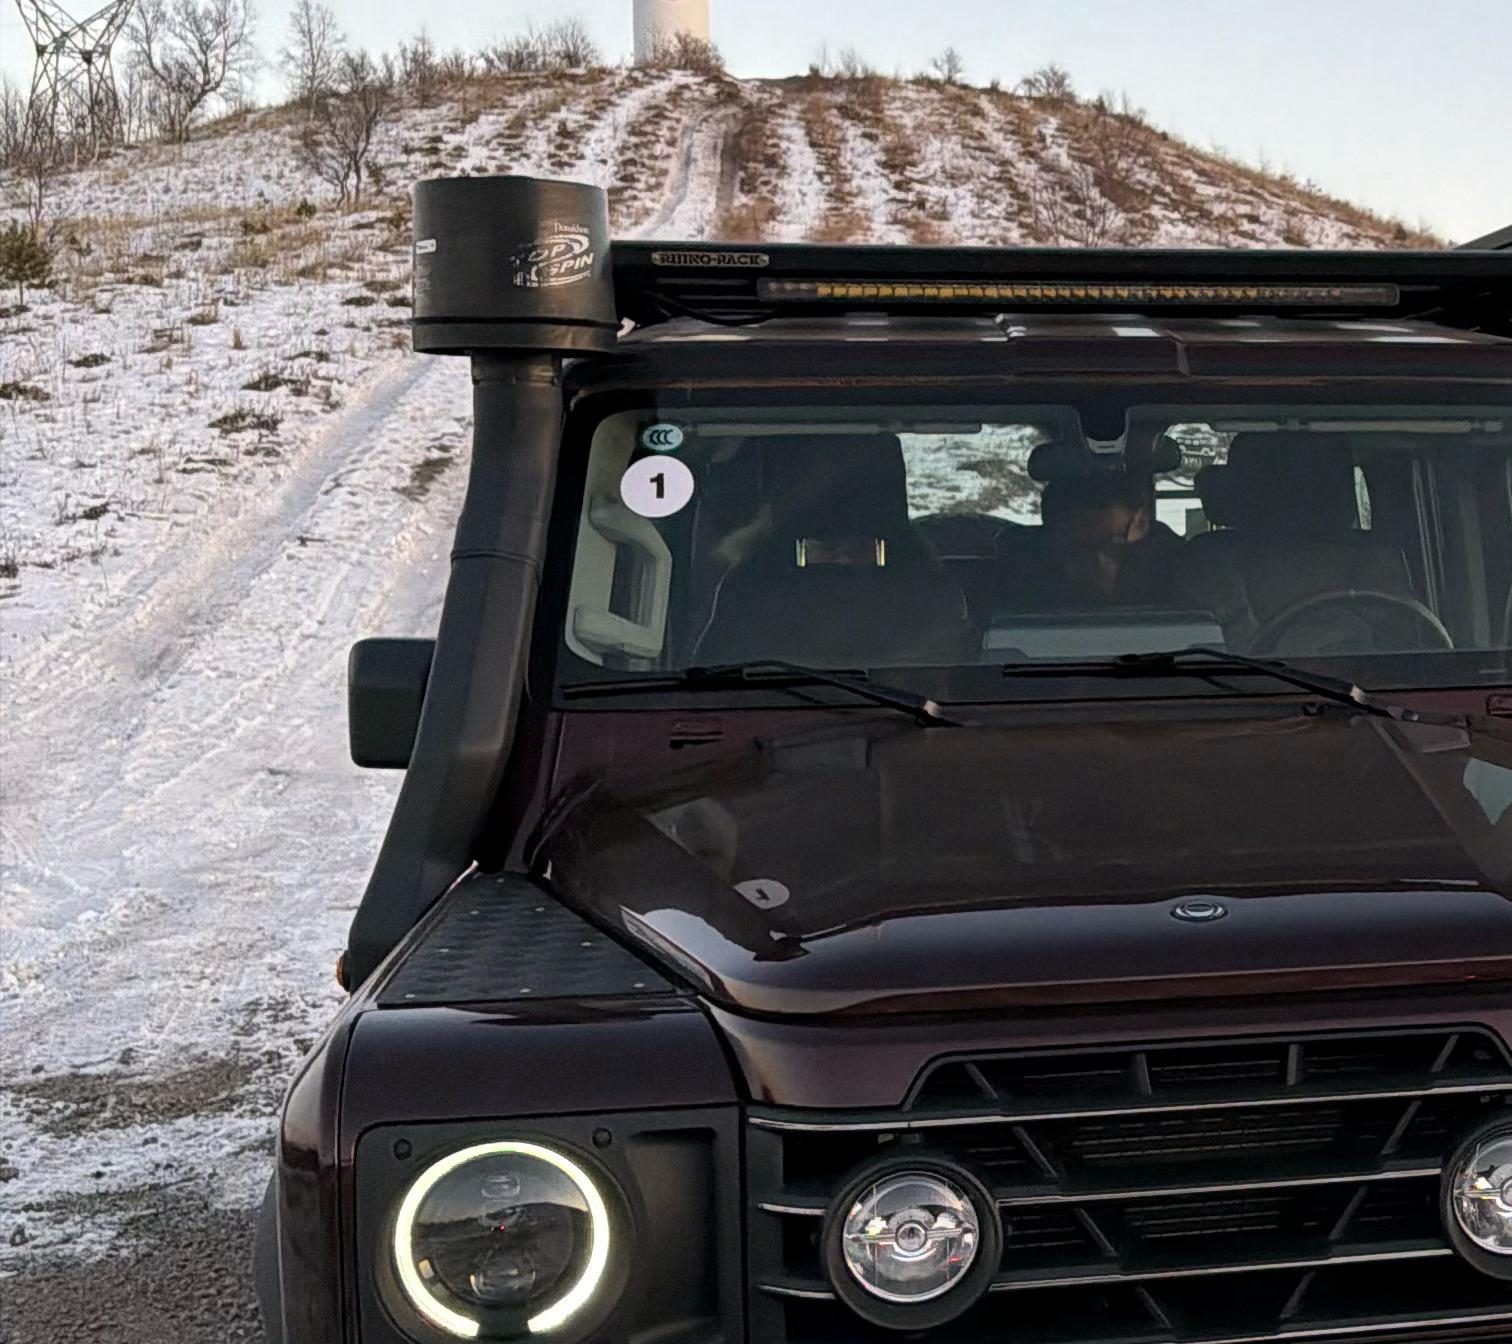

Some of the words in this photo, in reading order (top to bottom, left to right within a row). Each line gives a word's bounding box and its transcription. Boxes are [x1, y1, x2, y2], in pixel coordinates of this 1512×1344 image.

[549, 252, 594, 276] SPIN
[660, 253, 761, 265] RHINO-RACK
[650, 472, 665, 499] 1
